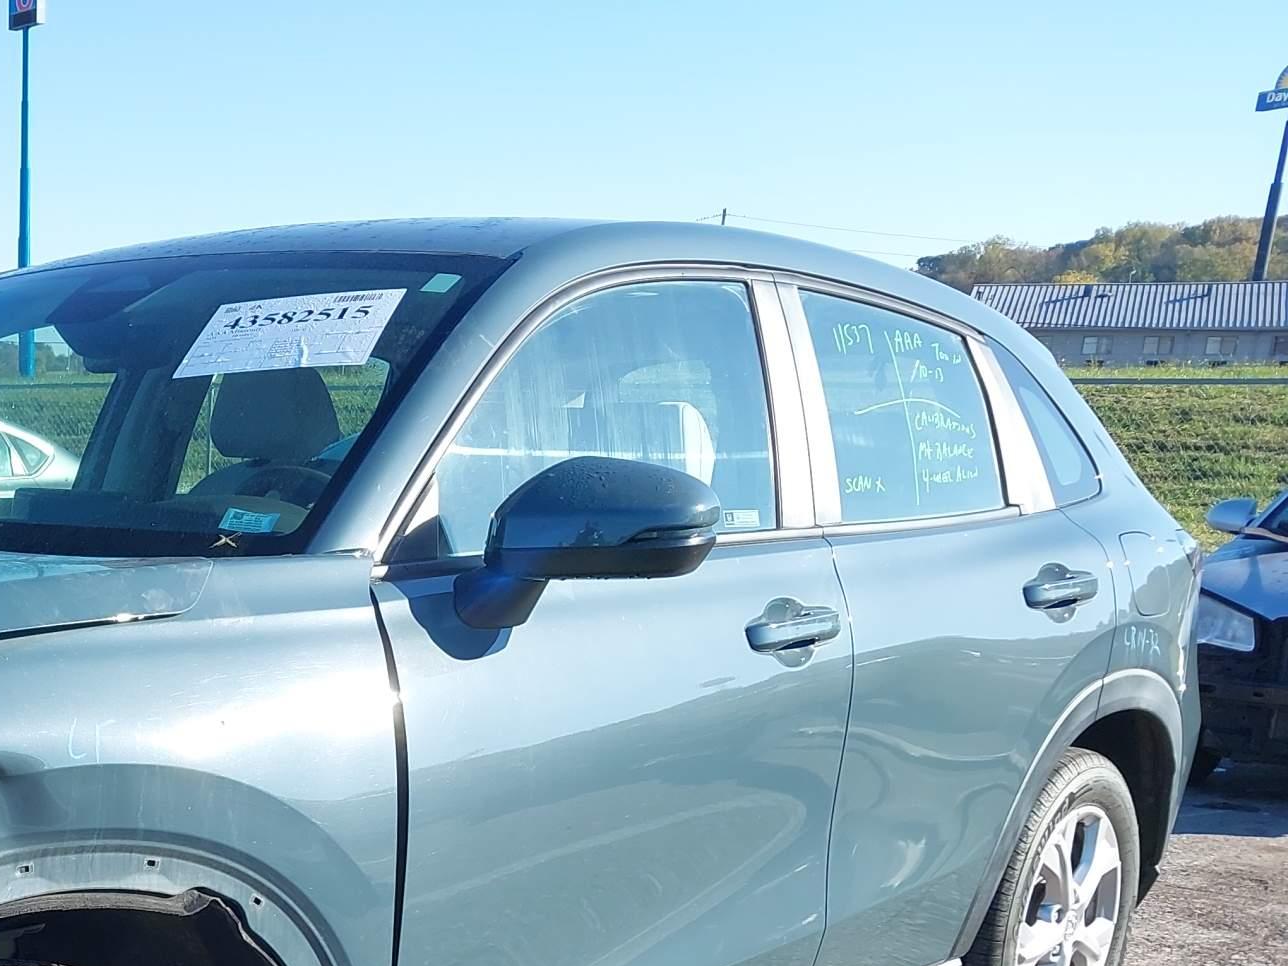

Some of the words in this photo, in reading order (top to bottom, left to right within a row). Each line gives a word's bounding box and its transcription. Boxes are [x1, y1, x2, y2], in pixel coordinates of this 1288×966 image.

[223, 305, 373, 330] 43582515
[833, 323, 874, 355] 11537
[893, 330, 923, 353] AAA
[844, 475, 872, 494] SCAN
